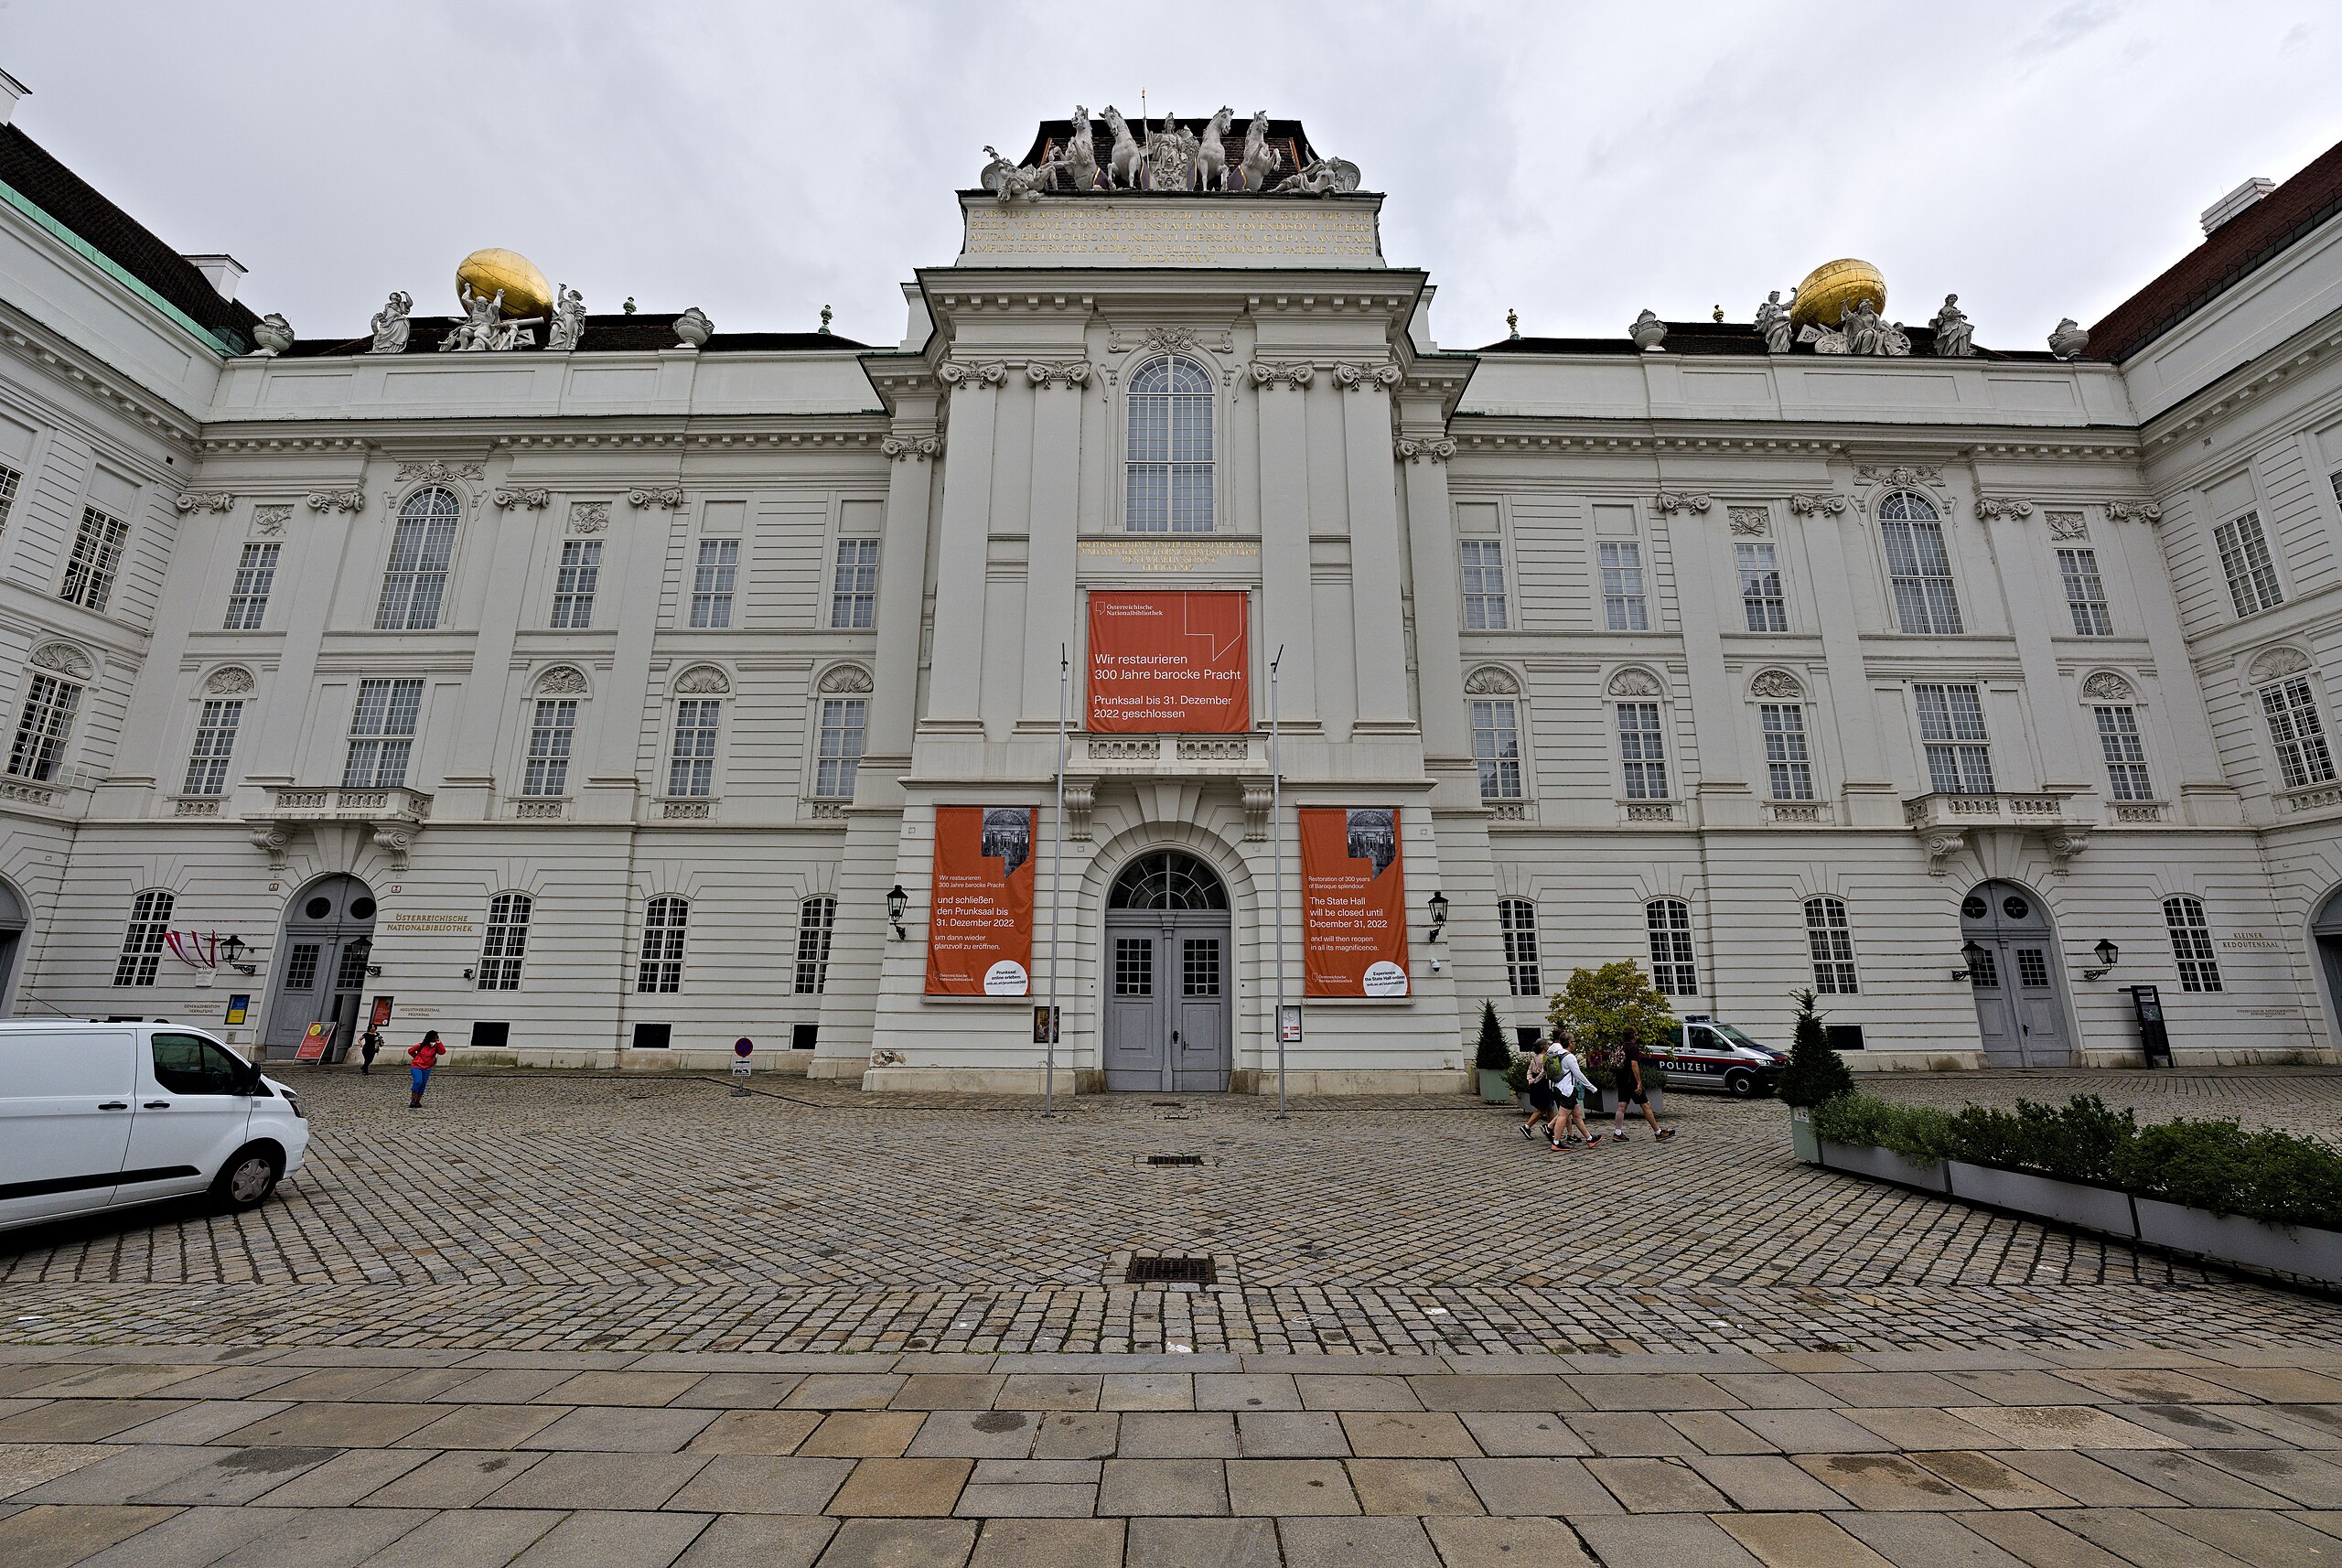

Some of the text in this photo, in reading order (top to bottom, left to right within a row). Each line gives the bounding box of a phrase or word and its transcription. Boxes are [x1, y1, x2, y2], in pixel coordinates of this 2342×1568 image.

[1069, 222, 1136, 231] CONFECTO
[1021, 233, 1120, 242] BIBLIOTHECAM
[1264, 234, 1308, 242] COPIA
[1095, 653, 1187, 664] Wir restaurieren
[1094, 670, 1241, 680] 300 Jahre barocke Pracht
[1094, 695, 1231, 705] Prunksaal bis 31. Dezember
[1093, 709, 1185, 720] 2022 geschlossen
[1309, 908, 1383, 917] will be closed until
[395, 914, 468, 922] ÖSTERREICHISCHE
[936, 918, 1015, 927] 31. Dezember 2022
[387, 924, 473, 932] NATIONALBIBLIOTHEK
[1310, 919, 1388, 929] December 31, 2022
[1659, 1060, 1706, 1071] POLIZEI
